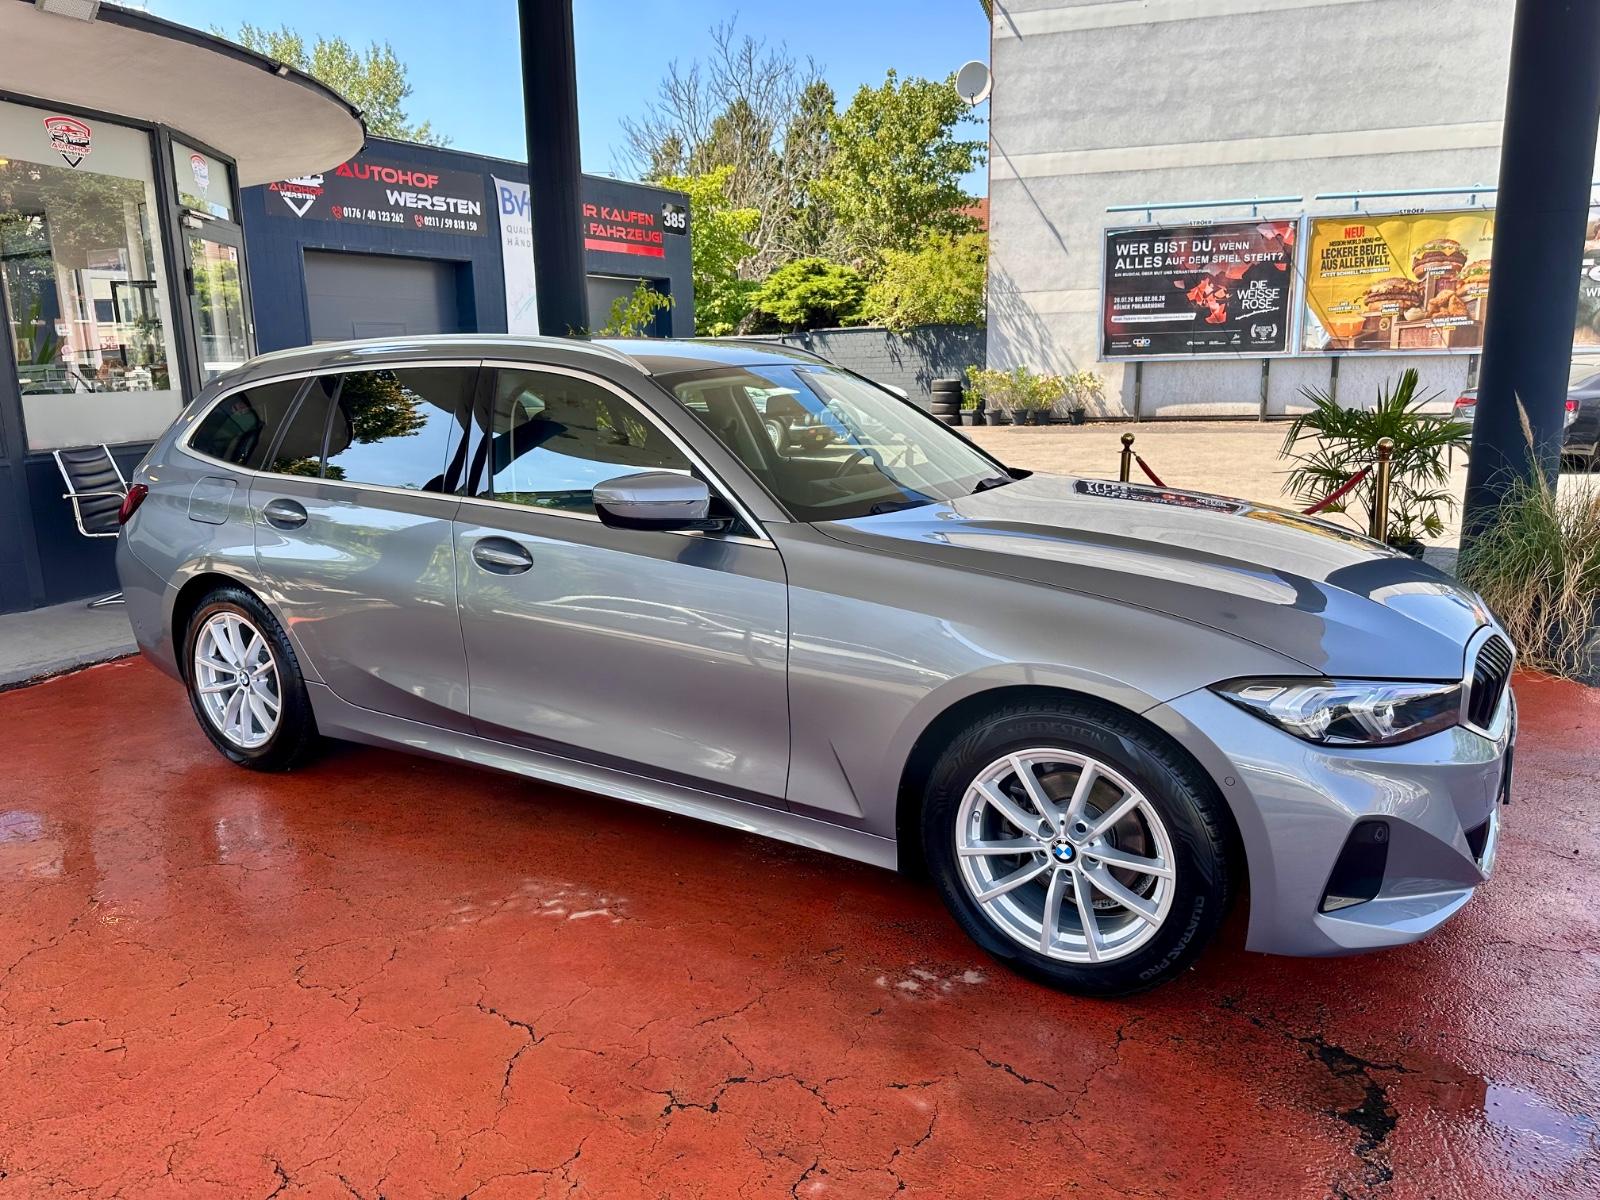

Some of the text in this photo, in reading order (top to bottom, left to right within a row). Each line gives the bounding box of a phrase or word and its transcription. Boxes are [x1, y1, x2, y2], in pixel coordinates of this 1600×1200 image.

[52, 142, 91, 153] AUTOHOF
[336, 162, 439, 189] AUTOHOF
[269, 182, 324, 196] AUTOHOF
[280, 190, 316, 200] WERSTEN
[386, 189, 481, 216] WERSTEN
[343, 206, 361, 219] 0176
[367, 209, 376, 220] 40
[378, 211, 390, 222] 123
[391, 213, 404, 224] 262
[583, 203, 654, 226] IR KAUFEN
[663, 211, 686, 229] 385
[424, 216, 439, 227] 0211
[445, 218, 453, 229] 59
[453, 219, 465, 230] 818
[590, 222, 663, 244] FAHRZEUG!
[1344, 226, 1365, 239] NEU!
[507, 237, 532, 248] HÄND
[1116, 239, 1250, 256] WER BIST DU, WENN
[1321, 243, 1387, 259] LECKERE BEUTE
[1114, 252, 1284, 269] ALLES AUF DEM SPIEL STEHT?
[1321, 255, 1390, 271] AUS ALLER WELT.
[1250, 280, 1268, 290] DIE
[1237, 288, 1280, 300] WEISSE
[1241, 299, 1273, 309] ROSE
[1139, 958, 1170, 980] PRO
